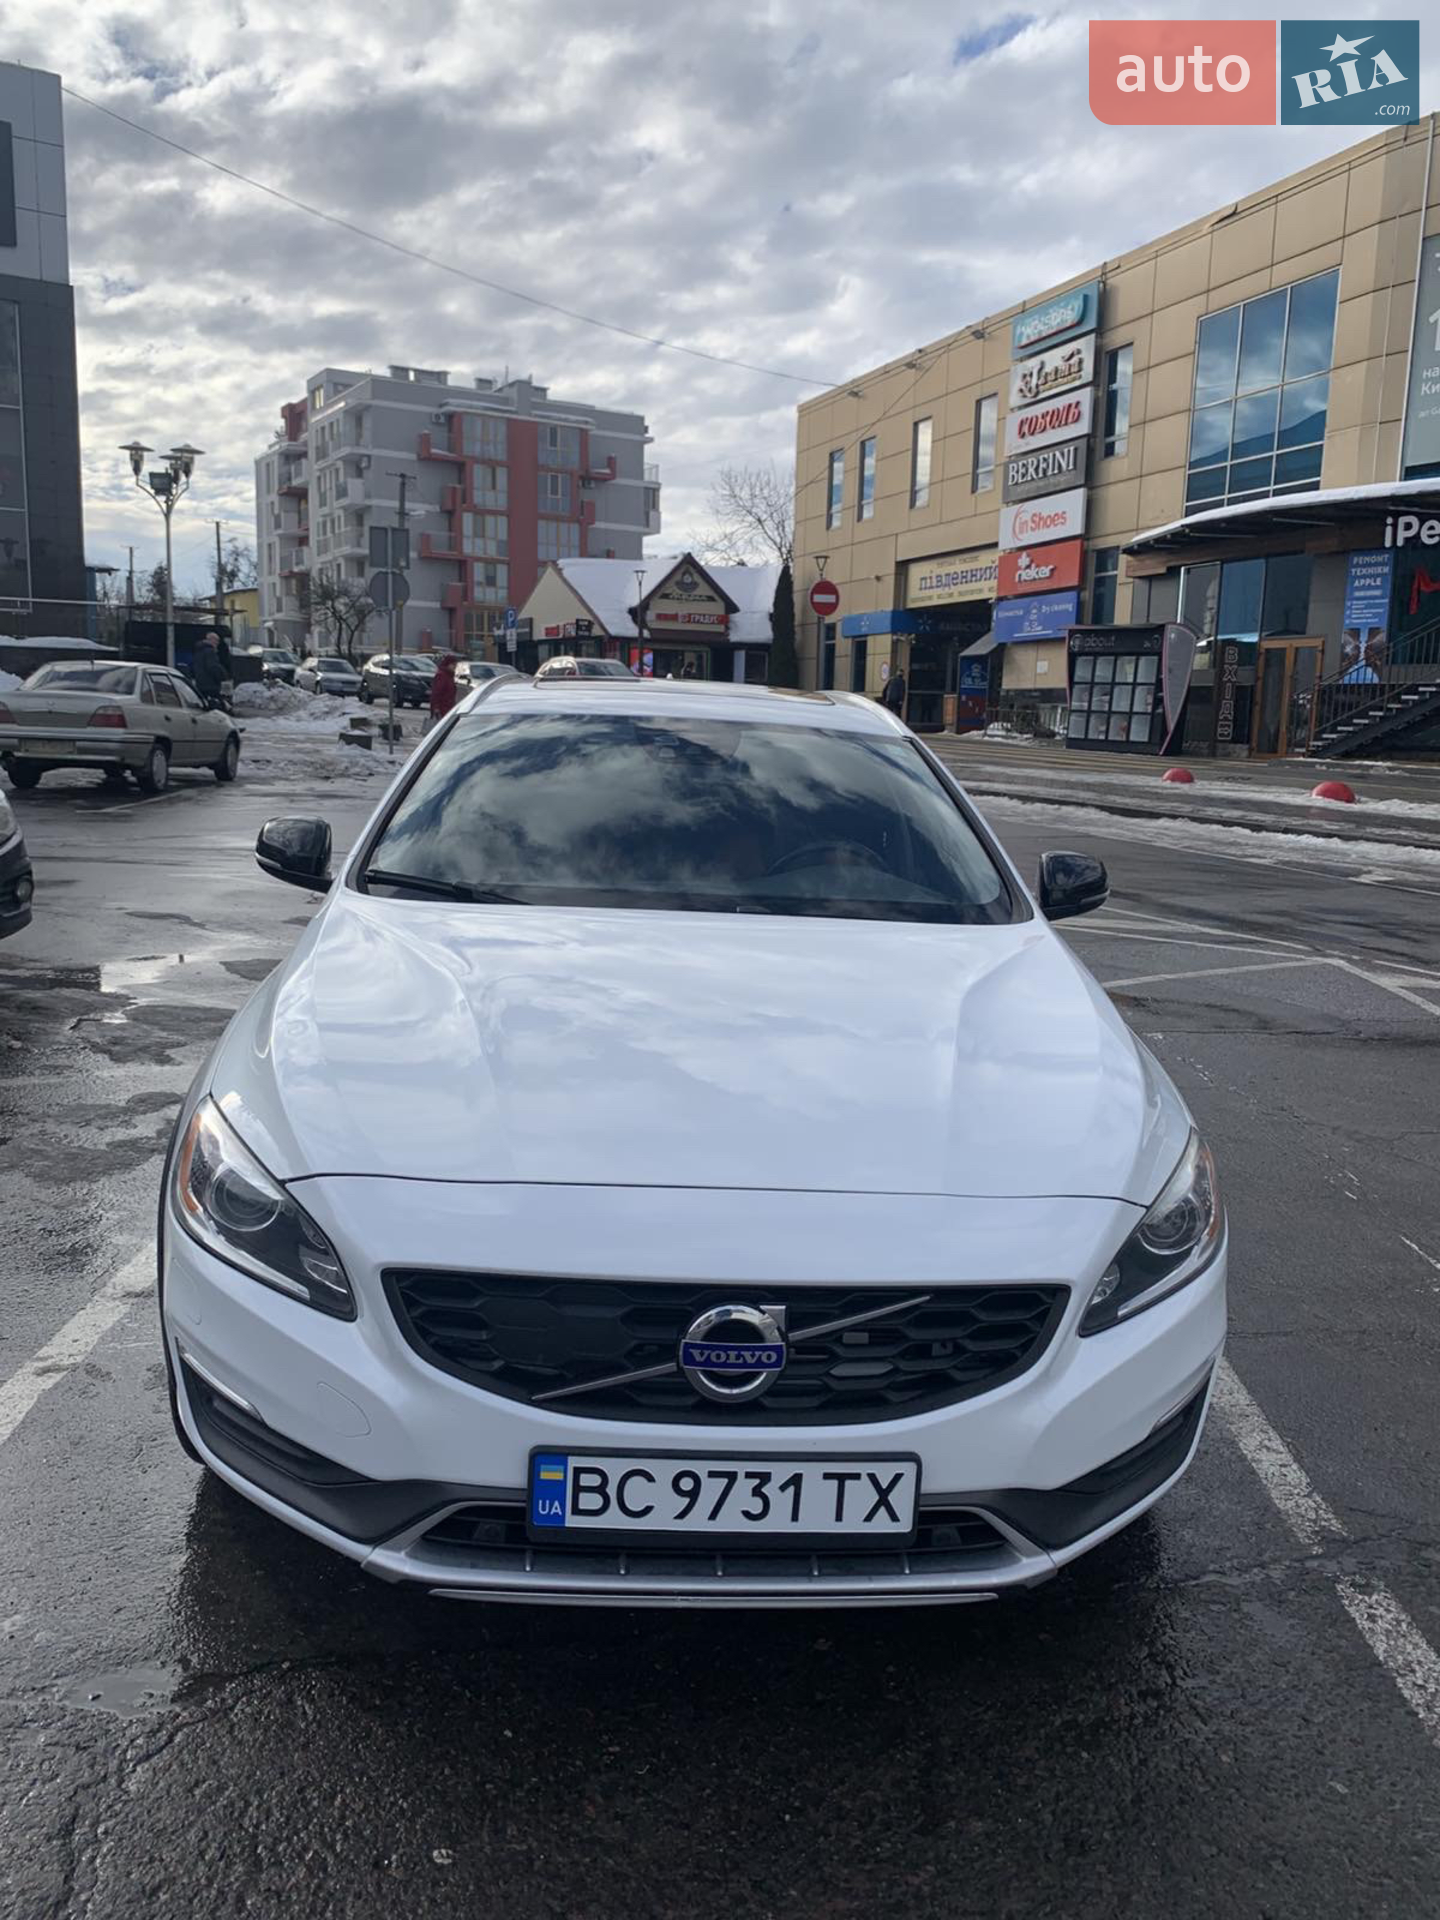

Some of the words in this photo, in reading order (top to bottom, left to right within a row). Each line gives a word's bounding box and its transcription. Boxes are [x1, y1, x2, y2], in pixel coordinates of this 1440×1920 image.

[1008, 446, 1075, 486] BERFINI
[1030, 511, 1067, 531] Shoes
[1352, 554, 1390, 565] РЕМОНТ
[1353, 577, 1382, 587] APPLE
[688, 1348, 778, 1364] VOLVO
[570, 1466, 656, 1519] BC
[670, 1469, 804, 1522] 9731
[822, 1472, 905, 1523] TX
[538, 1500, 562, 1516] UA
